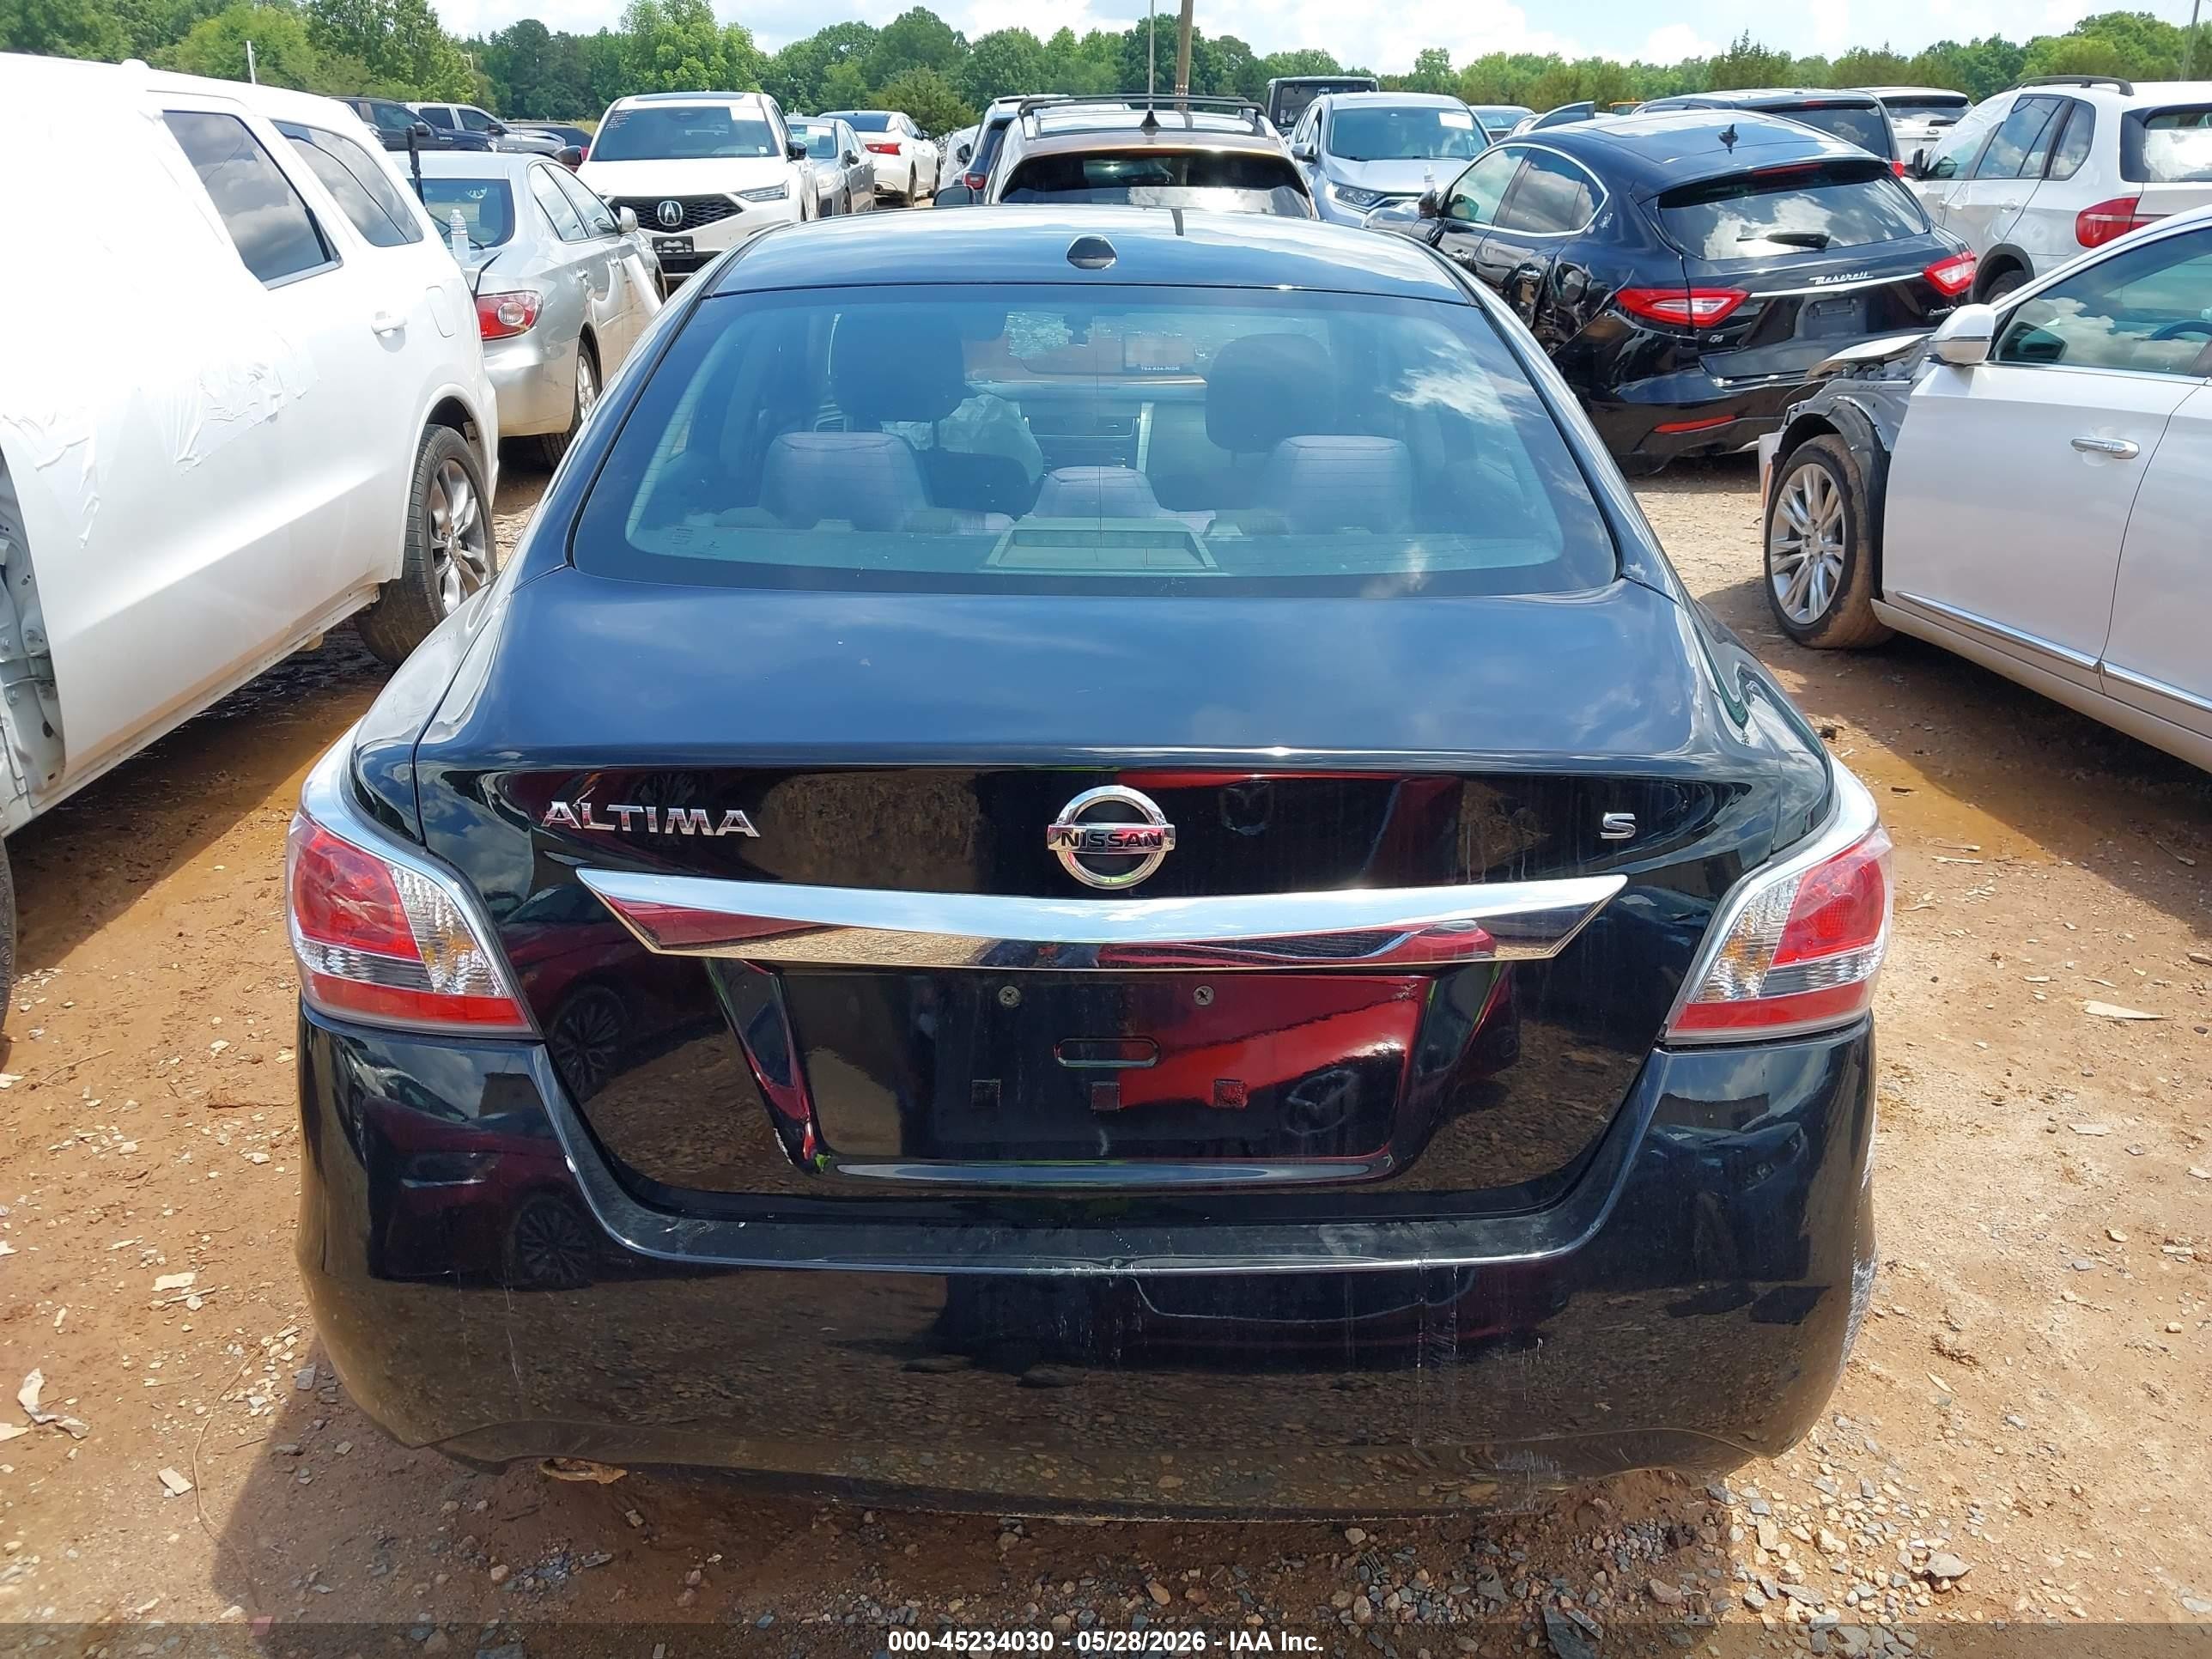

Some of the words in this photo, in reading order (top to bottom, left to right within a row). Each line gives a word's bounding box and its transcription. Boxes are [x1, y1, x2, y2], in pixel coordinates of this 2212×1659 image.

[541, 800, 762, 838] ALTIMA
[1600, 811, 1636, 839] S
[1060, 831, 1164, 848] NISSAN
